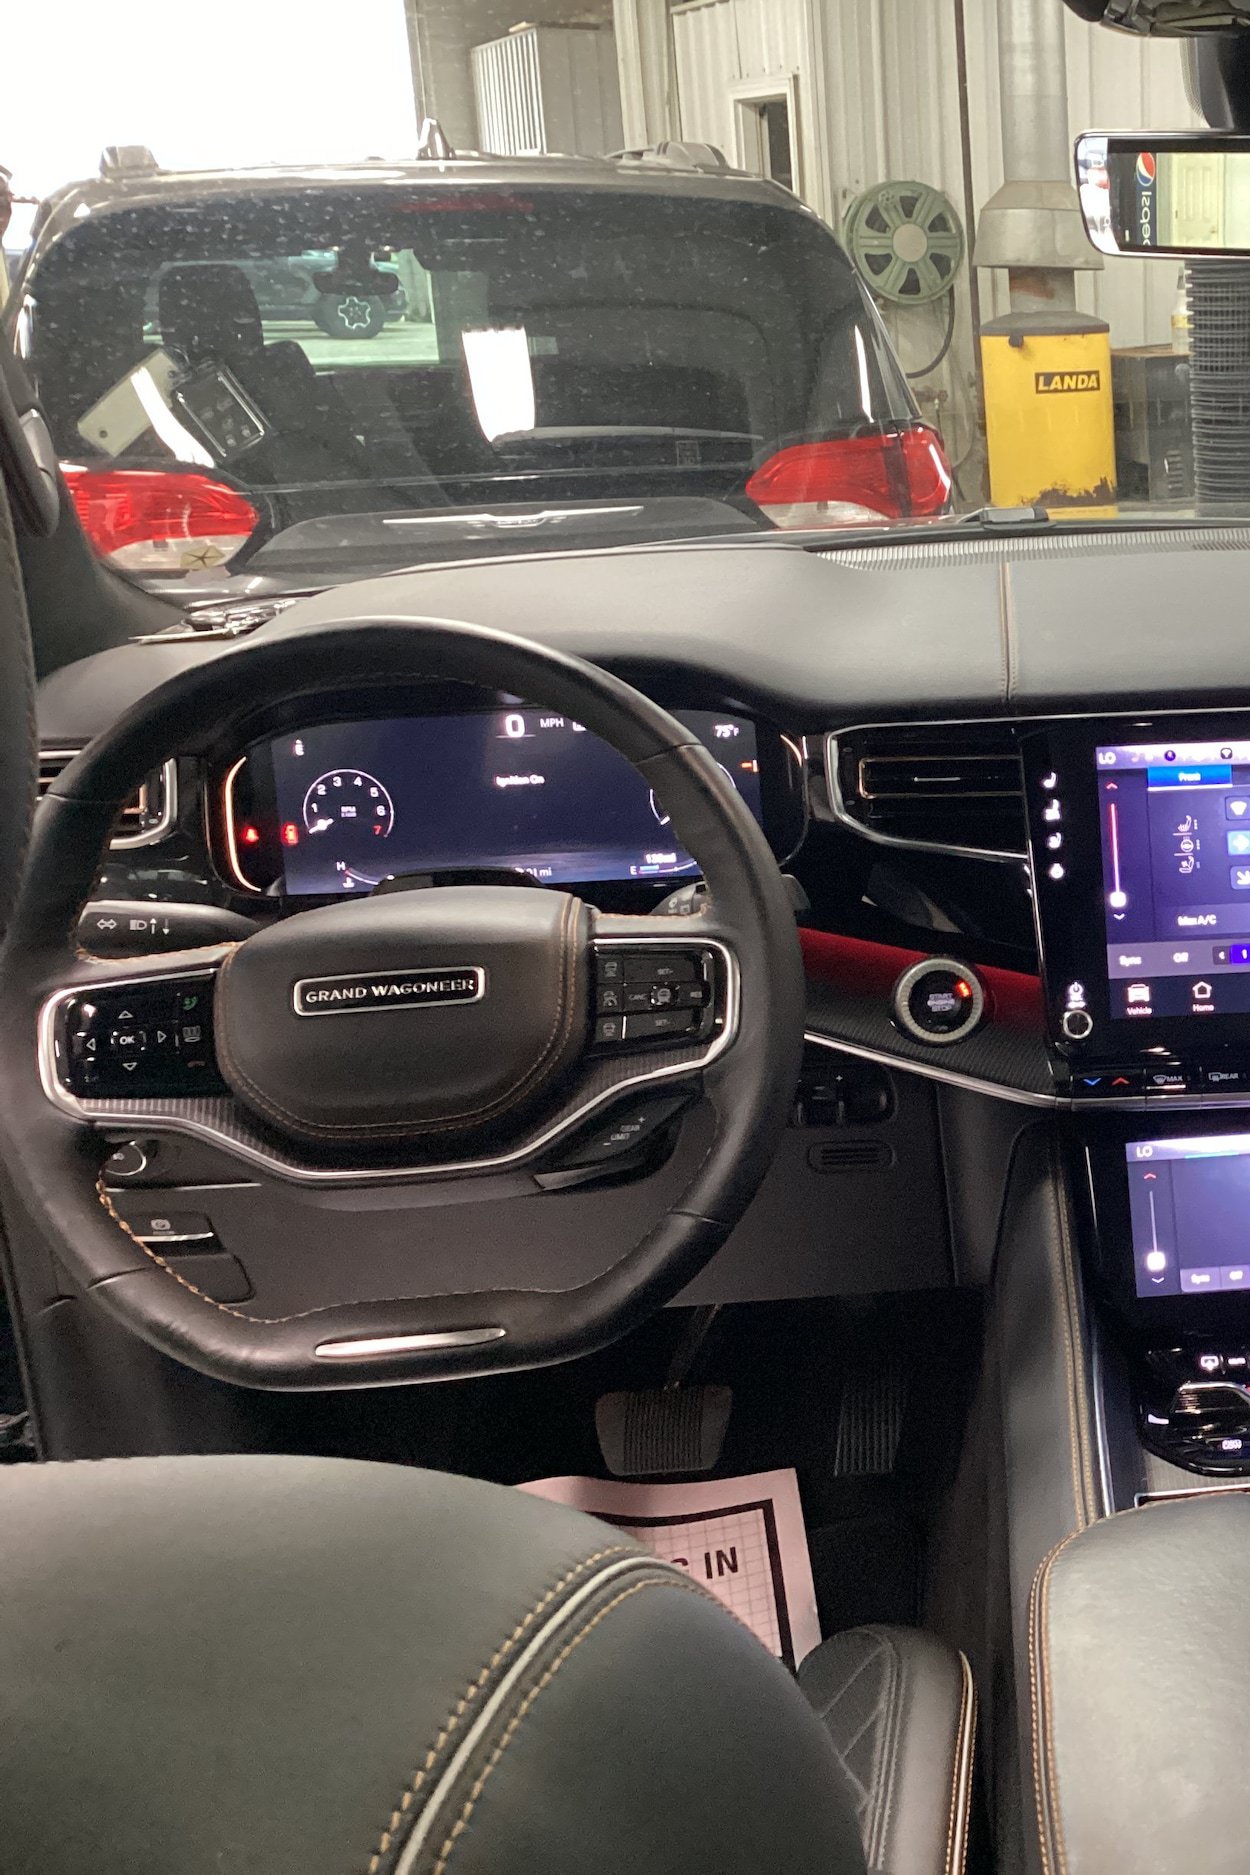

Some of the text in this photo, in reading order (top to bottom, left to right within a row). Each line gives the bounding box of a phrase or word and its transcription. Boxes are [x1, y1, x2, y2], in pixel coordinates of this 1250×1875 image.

[1038, 374, 1098, 390] LANDA
[505, 714, 564, 738] 0 MPH
[1099, 751, 1116, 765] LO
[332, 776, 342, 788] 3
[353, 776, 363, 787] 4
[317, 784, 327, 796] 2
[370, 787, 380, 798] 5
[311, 802, 318, 813] 1
[376, 805, 386, 817] 6
[373, 825, 382, 836] 7
[336, 861, 346, 871] H
[630, 866, 638, 875] E
[305, 979, 474, 1003] GRAND WAGONEER
[1127, 1007, 1153, 1015] Vehicle
[1193, 1003, 1215, 1013] Home
[120, 1036, 136, 1045] OK
[1136, 1145, 1153, 1158] LO
[704, 1546, 739, 1579] IN
